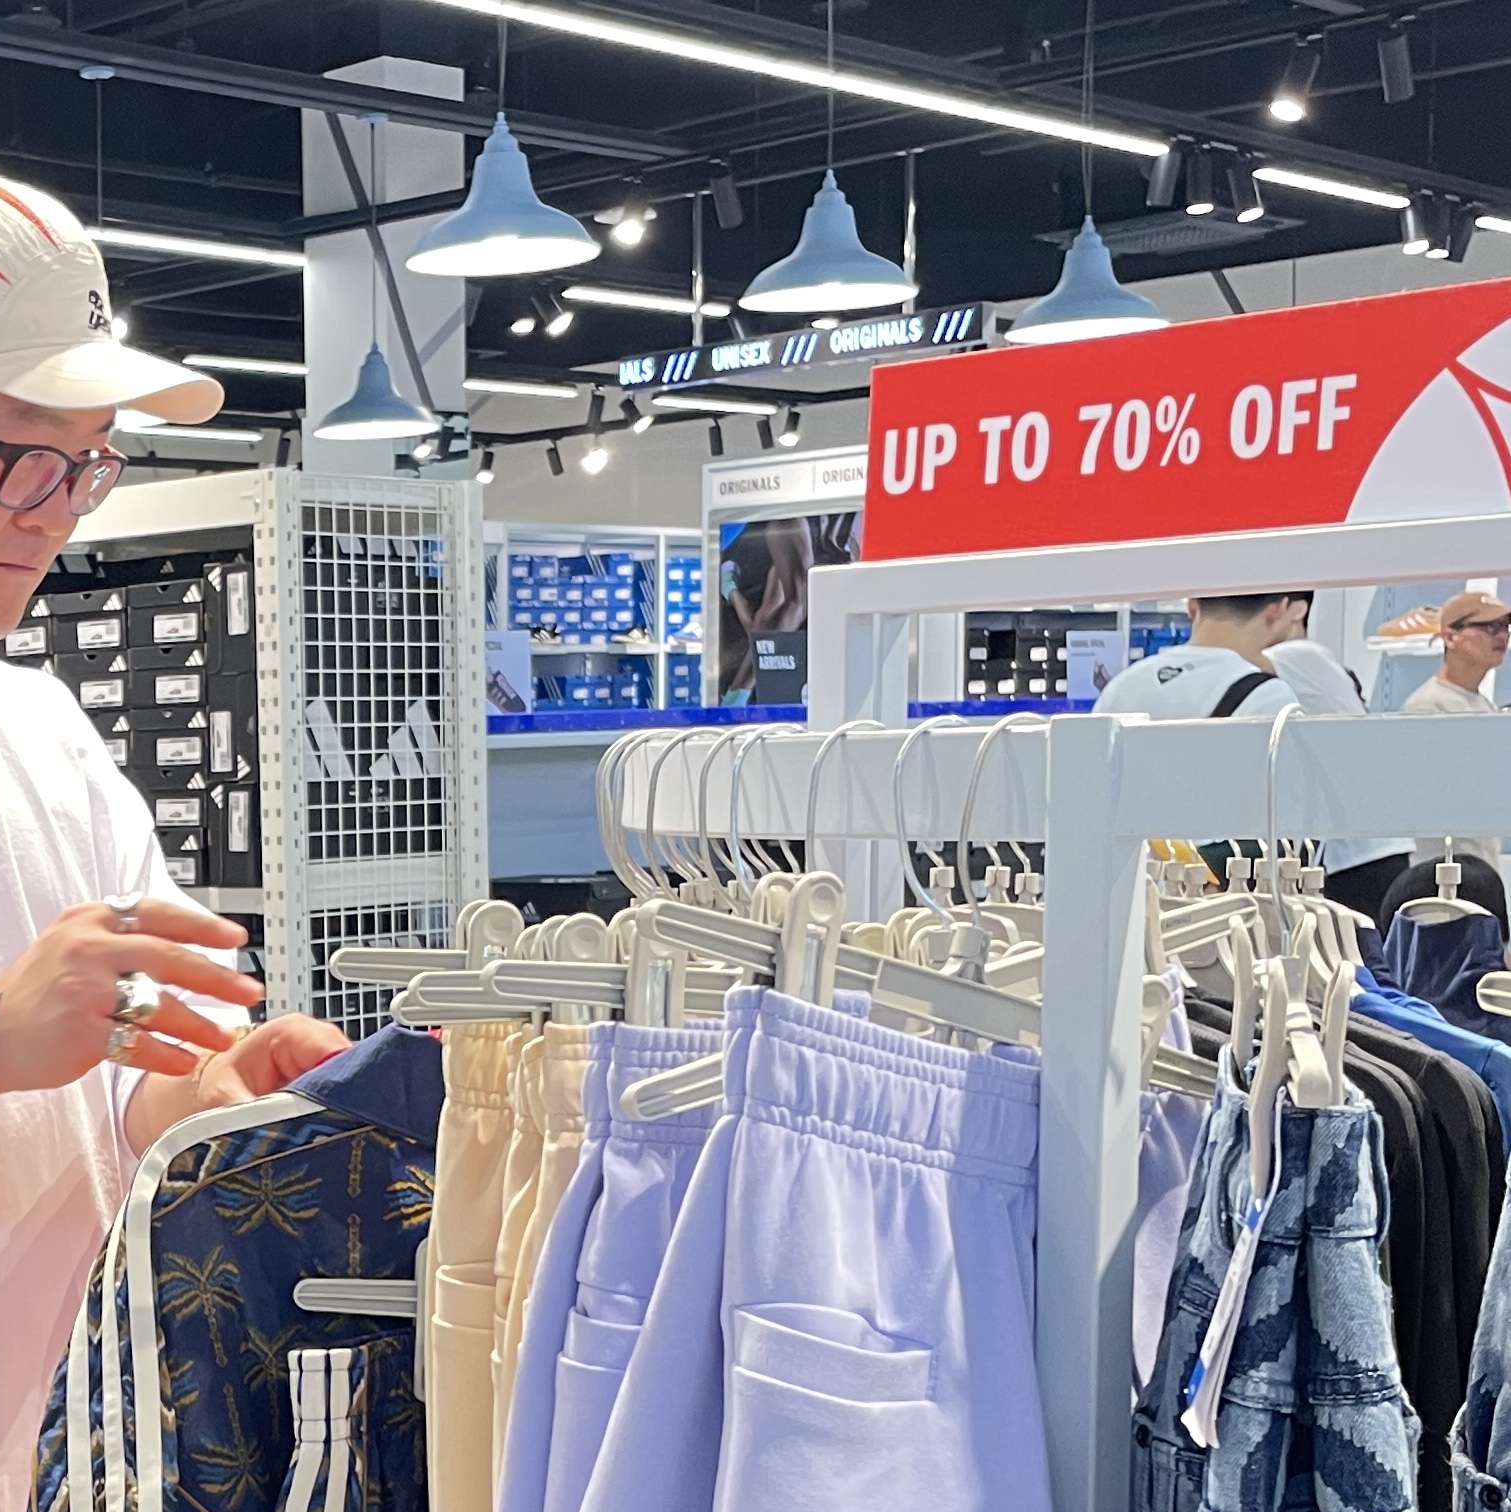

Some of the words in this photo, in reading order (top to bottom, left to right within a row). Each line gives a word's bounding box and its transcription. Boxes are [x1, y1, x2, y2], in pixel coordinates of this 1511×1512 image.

[711, 339, 772, 372] UNISEX
[829, 316, 924, 354] ORIGINALS
[882, 423, 958, 495] UP
[978, 411, 1050, 484] TO
[1078, 392, 1201, 475] 70%
[1229, 373, 1358, 460] OFF
[719, 475, 781, 496] ORIGINALS
[755, 640, 775, 654] NEW
[758, 655, 796, 670] ARRIVALS
